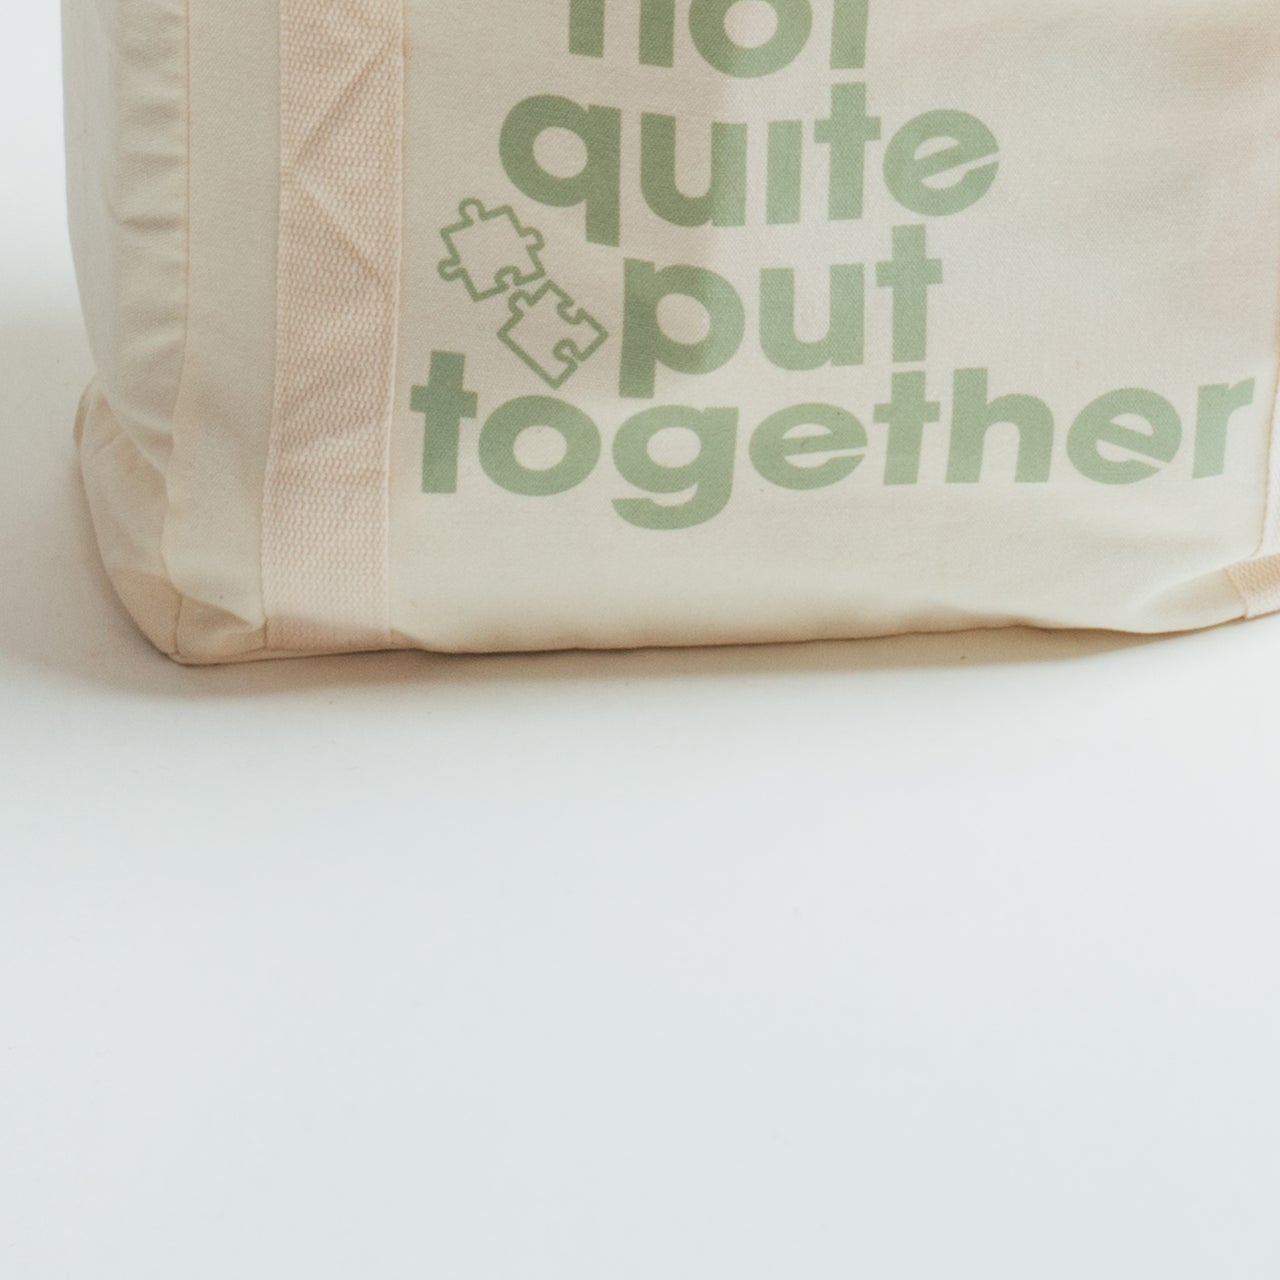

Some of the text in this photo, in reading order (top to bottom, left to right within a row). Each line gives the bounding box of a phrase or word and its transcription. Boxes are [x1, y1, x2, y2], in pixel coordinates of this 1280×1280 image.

[497, 80, 1001, 248] quite
[617, 223, 944, 400] put
[409, 349, 1256, 531] together
